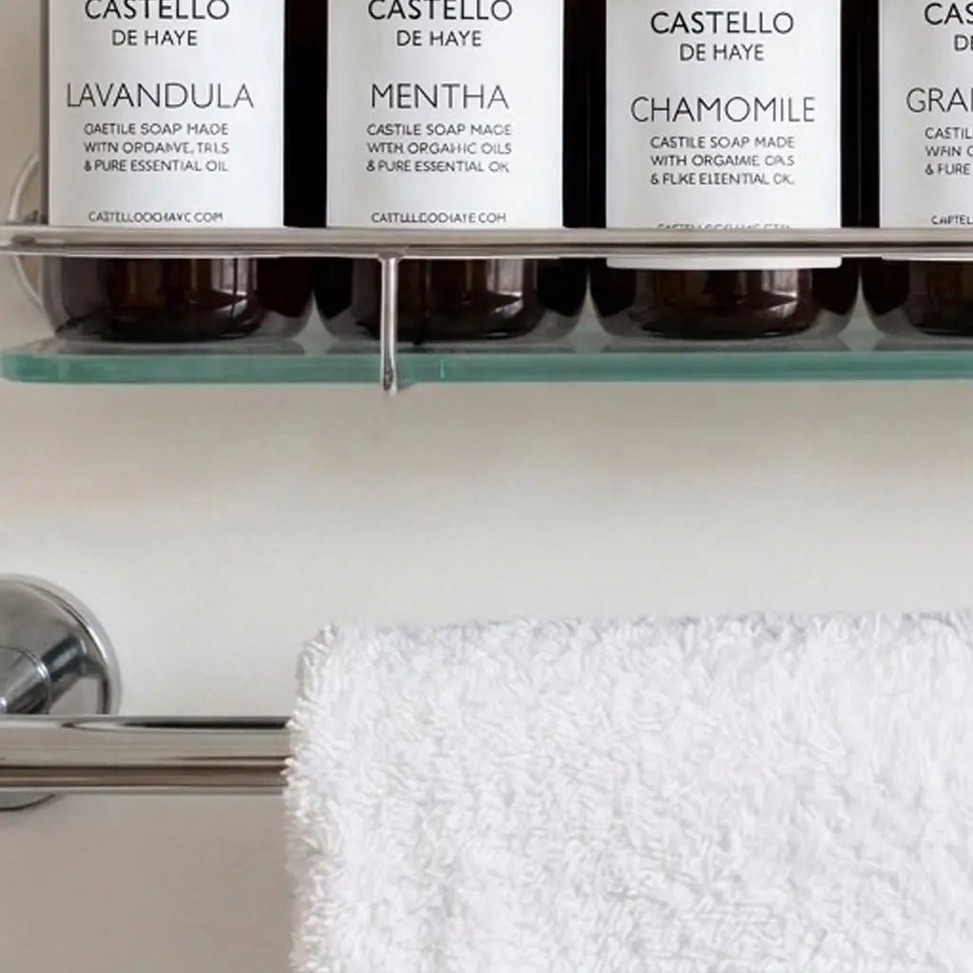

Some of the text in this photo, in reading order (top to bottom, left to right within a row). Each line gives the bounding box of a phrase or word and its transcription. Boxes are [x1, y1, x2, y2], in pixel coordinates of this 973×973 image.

[650, 11, 793, 34] CASTELLO
[112, 29, 197, 46] DE HAYE
[397, 30, 481, 46] DE HAYE
[680, 43, 763, 61] DE HAYE
[67, 82, 253, 109] LAVANDULA
[372, 83, 508, 109] MENTHA
[631, 96, 814, 123] CHAMOMILE
[140, 123, 182, 136] SOAP
[366, 123, 421, 136] CASTILE
[426, 123, 466, 136] SOAP
[480, 142, 512, 155] OILS
[650, 136, 794, 149] CASTILE SOAP MADE
[94, 159, 127, 172] PURE
[130, 159, 202, 172] ESSENTIAL
[205, 160, 228, 172] OIL
[366, 159, 375, 171] &
[378, 159, 411, 172] PURE
[414, 160, 484, 172] ESSENTIAL
[650, 155, 687, 166] WITH
[925, 163, 934, 175] &
